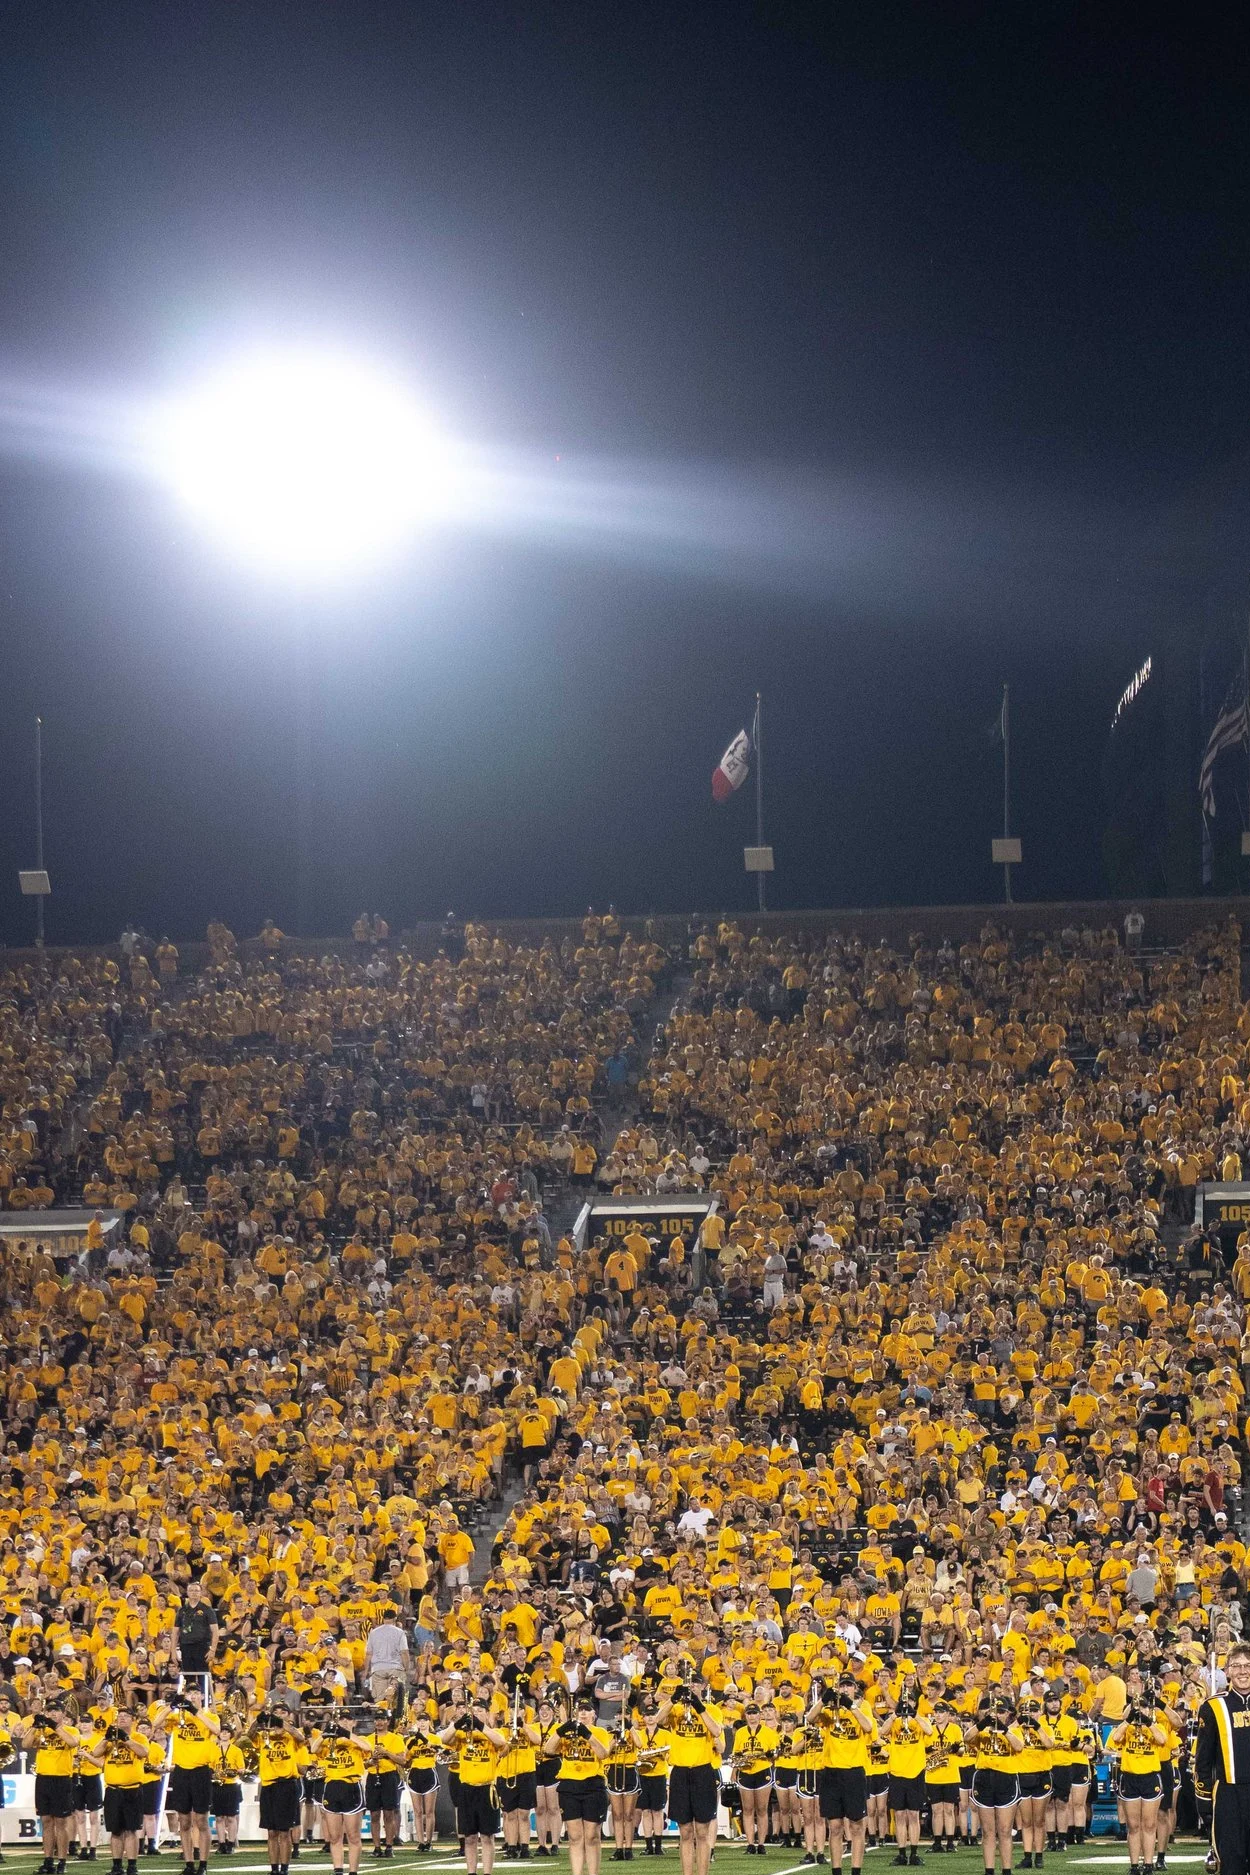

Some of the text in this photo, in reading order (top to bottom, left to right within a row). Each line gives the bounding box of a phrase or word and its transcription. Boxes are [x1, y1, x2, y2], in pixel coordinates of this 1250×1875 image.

[659, 1218, 694, 1235] 105
[648, 1395, 663, 1403] IOWA
[347, 1607, 364, 1615] IOWA
[874, 1608, 893, 1618] IOWA
[764, 1667, 783, 1675] IOWA
[180, 1729, 201, 1738] IOWA
